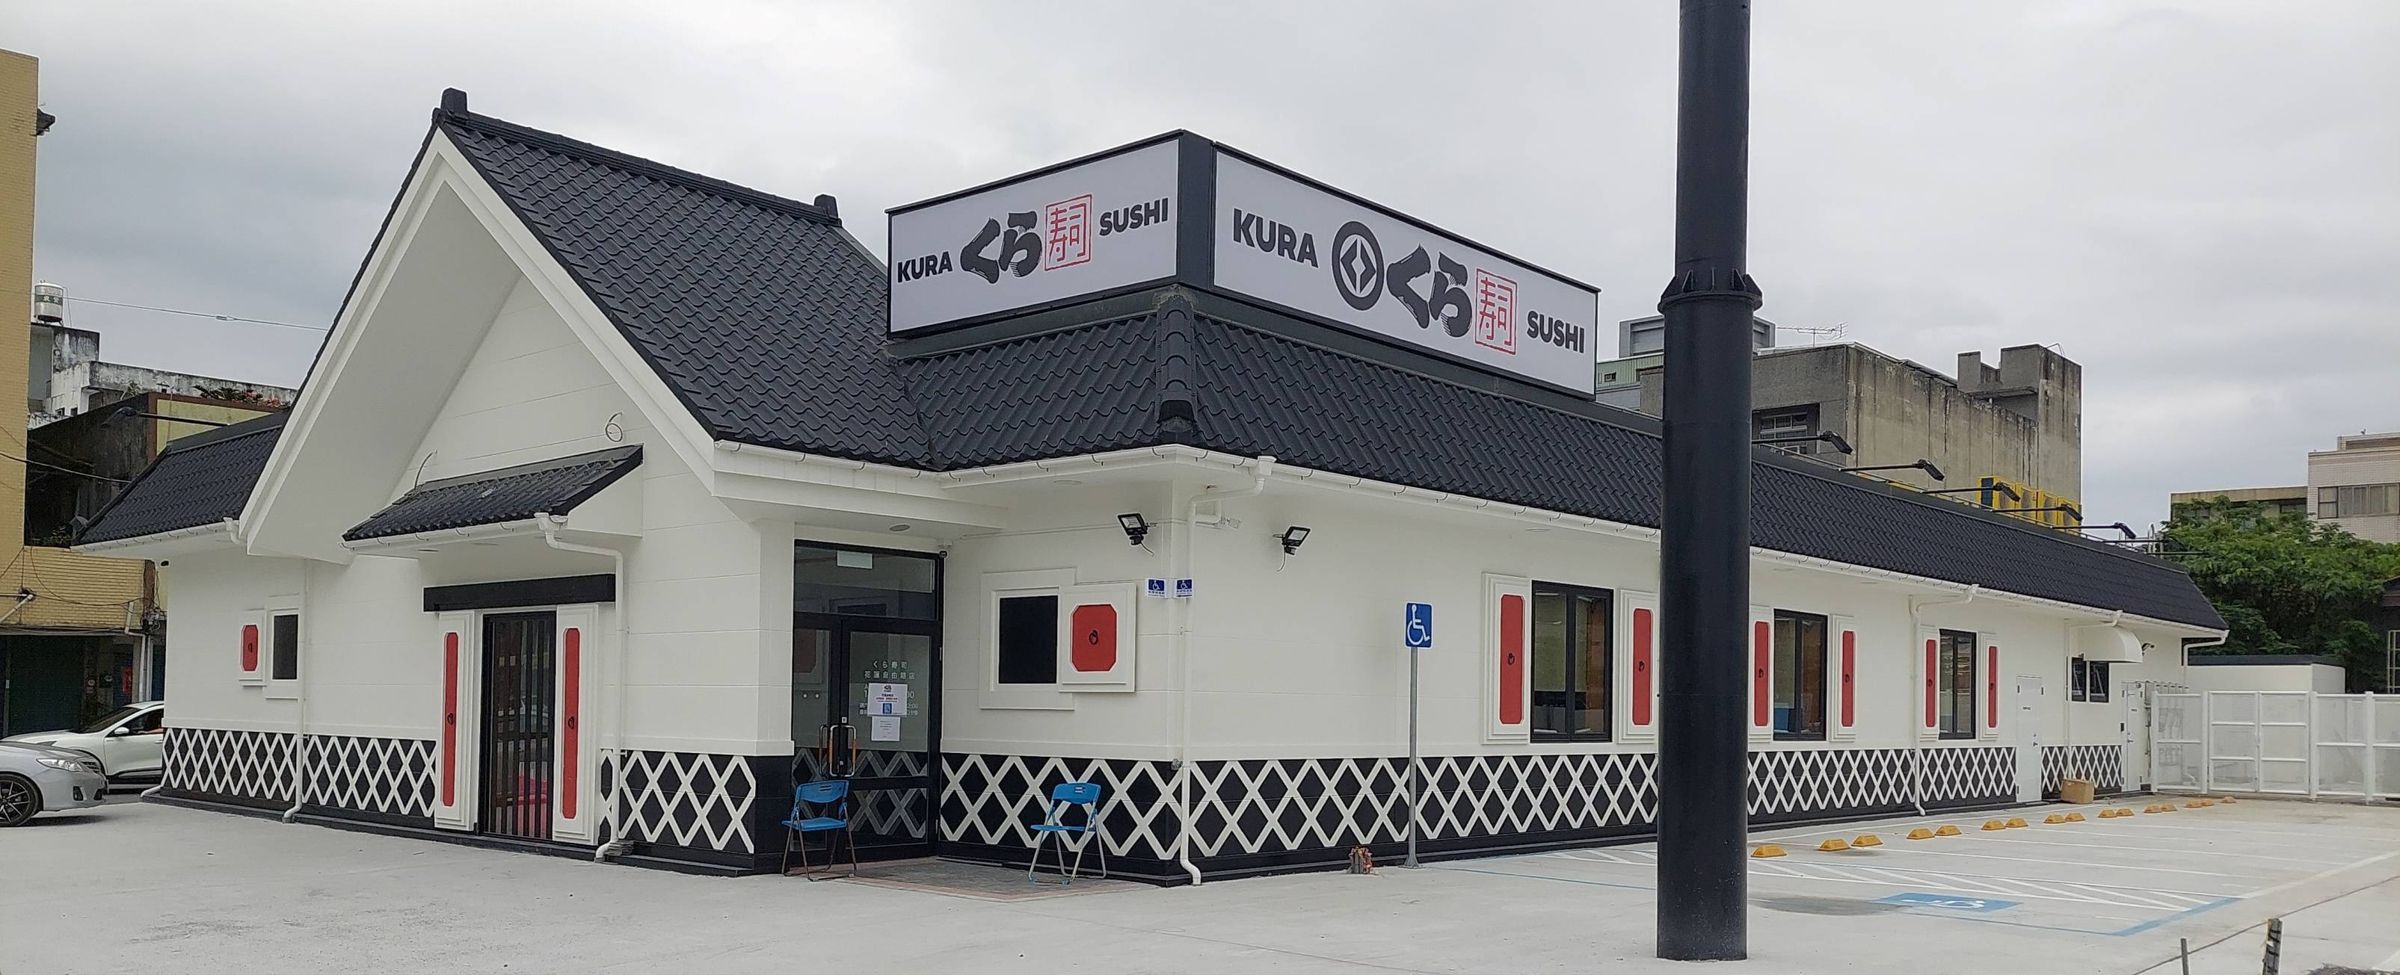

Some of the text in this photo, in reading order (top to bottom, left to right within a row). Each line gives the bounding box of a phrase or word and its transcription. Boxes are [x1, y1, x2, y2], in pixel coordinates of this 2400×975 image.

[898, 251, 953, 283] KURA
[1099, 197, 1169, 236] SUSHI
[1233, 208, 1319, 268] KURA
[1526, 310, 1585, 354] SUSHI
